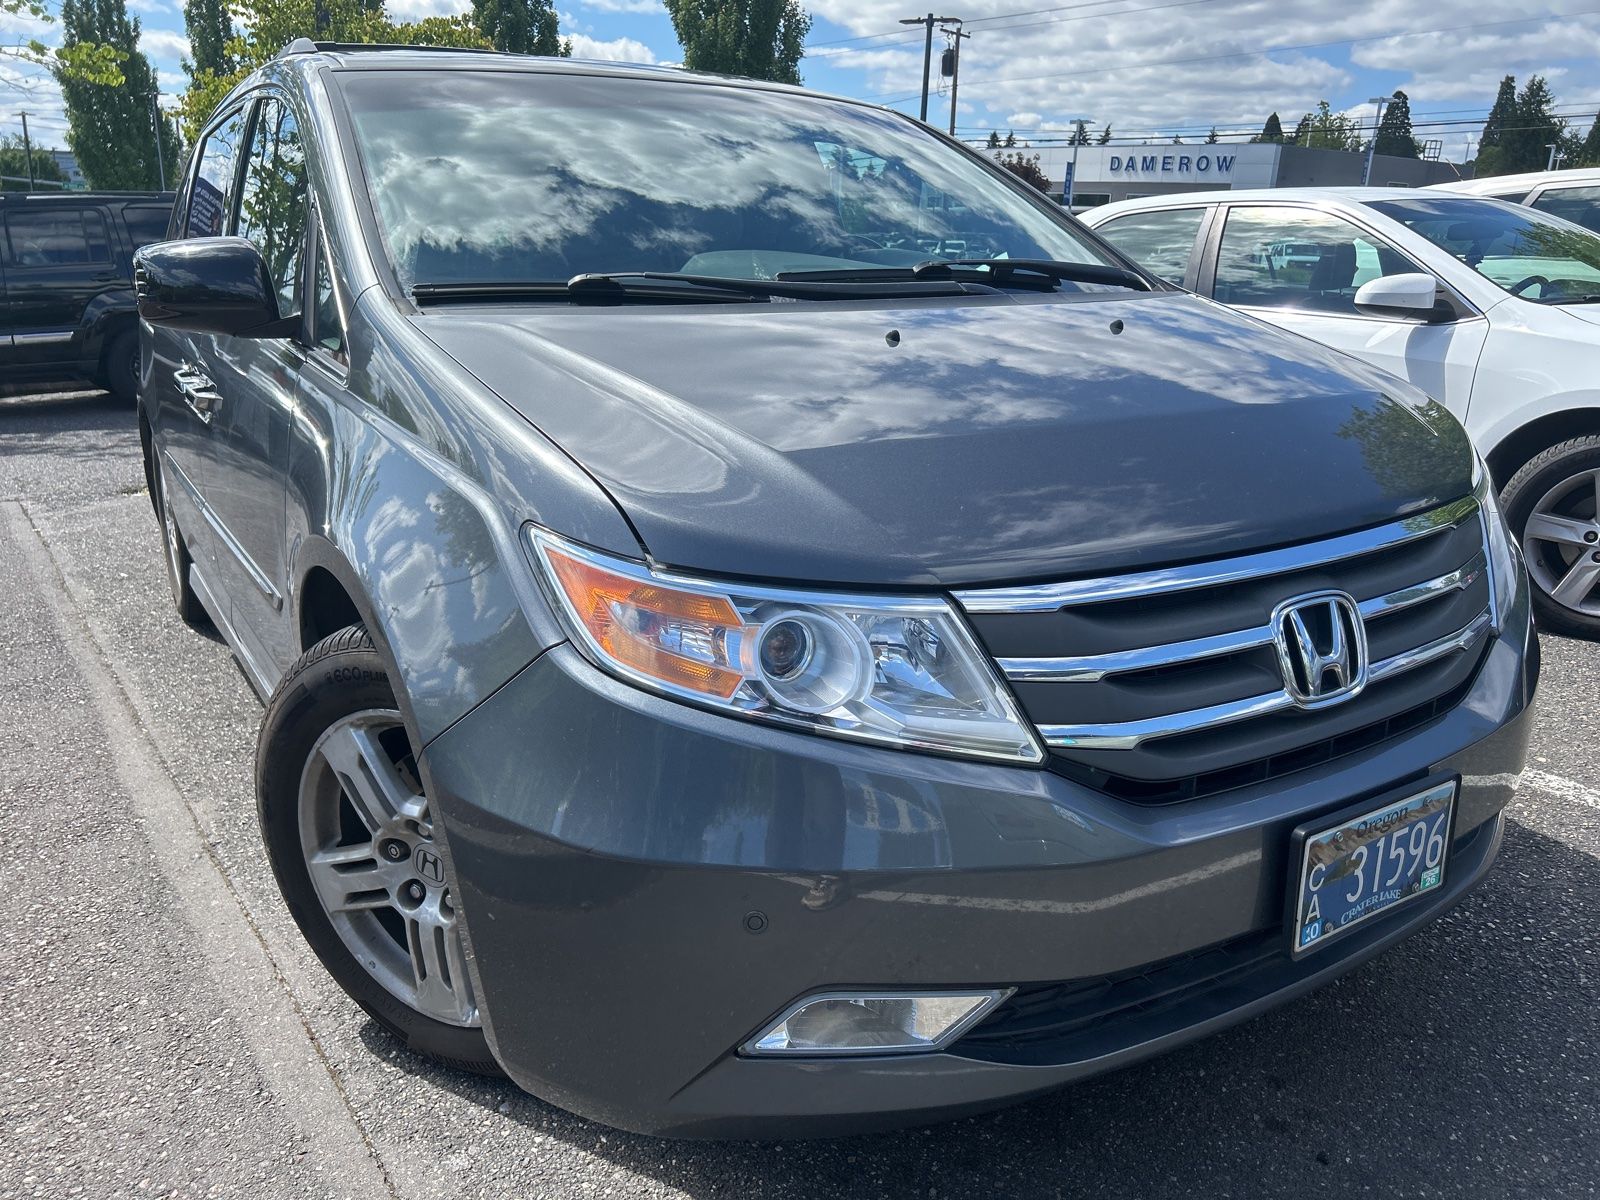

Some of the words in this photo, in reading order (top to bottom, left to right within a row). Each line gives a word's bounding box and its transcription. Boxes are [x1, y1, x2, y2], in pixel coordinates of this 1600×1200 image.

[1109, 155, 1235, 172] DAMEROW
[1356, 806, 1409, 838] Oregon
[1346, 813, 1445, 903] 31596
[1425, 875, 1436, 887] 26
[1340, 894, 1379, 926] CRATER
[1379, 889, 1403, 901] LAKE
